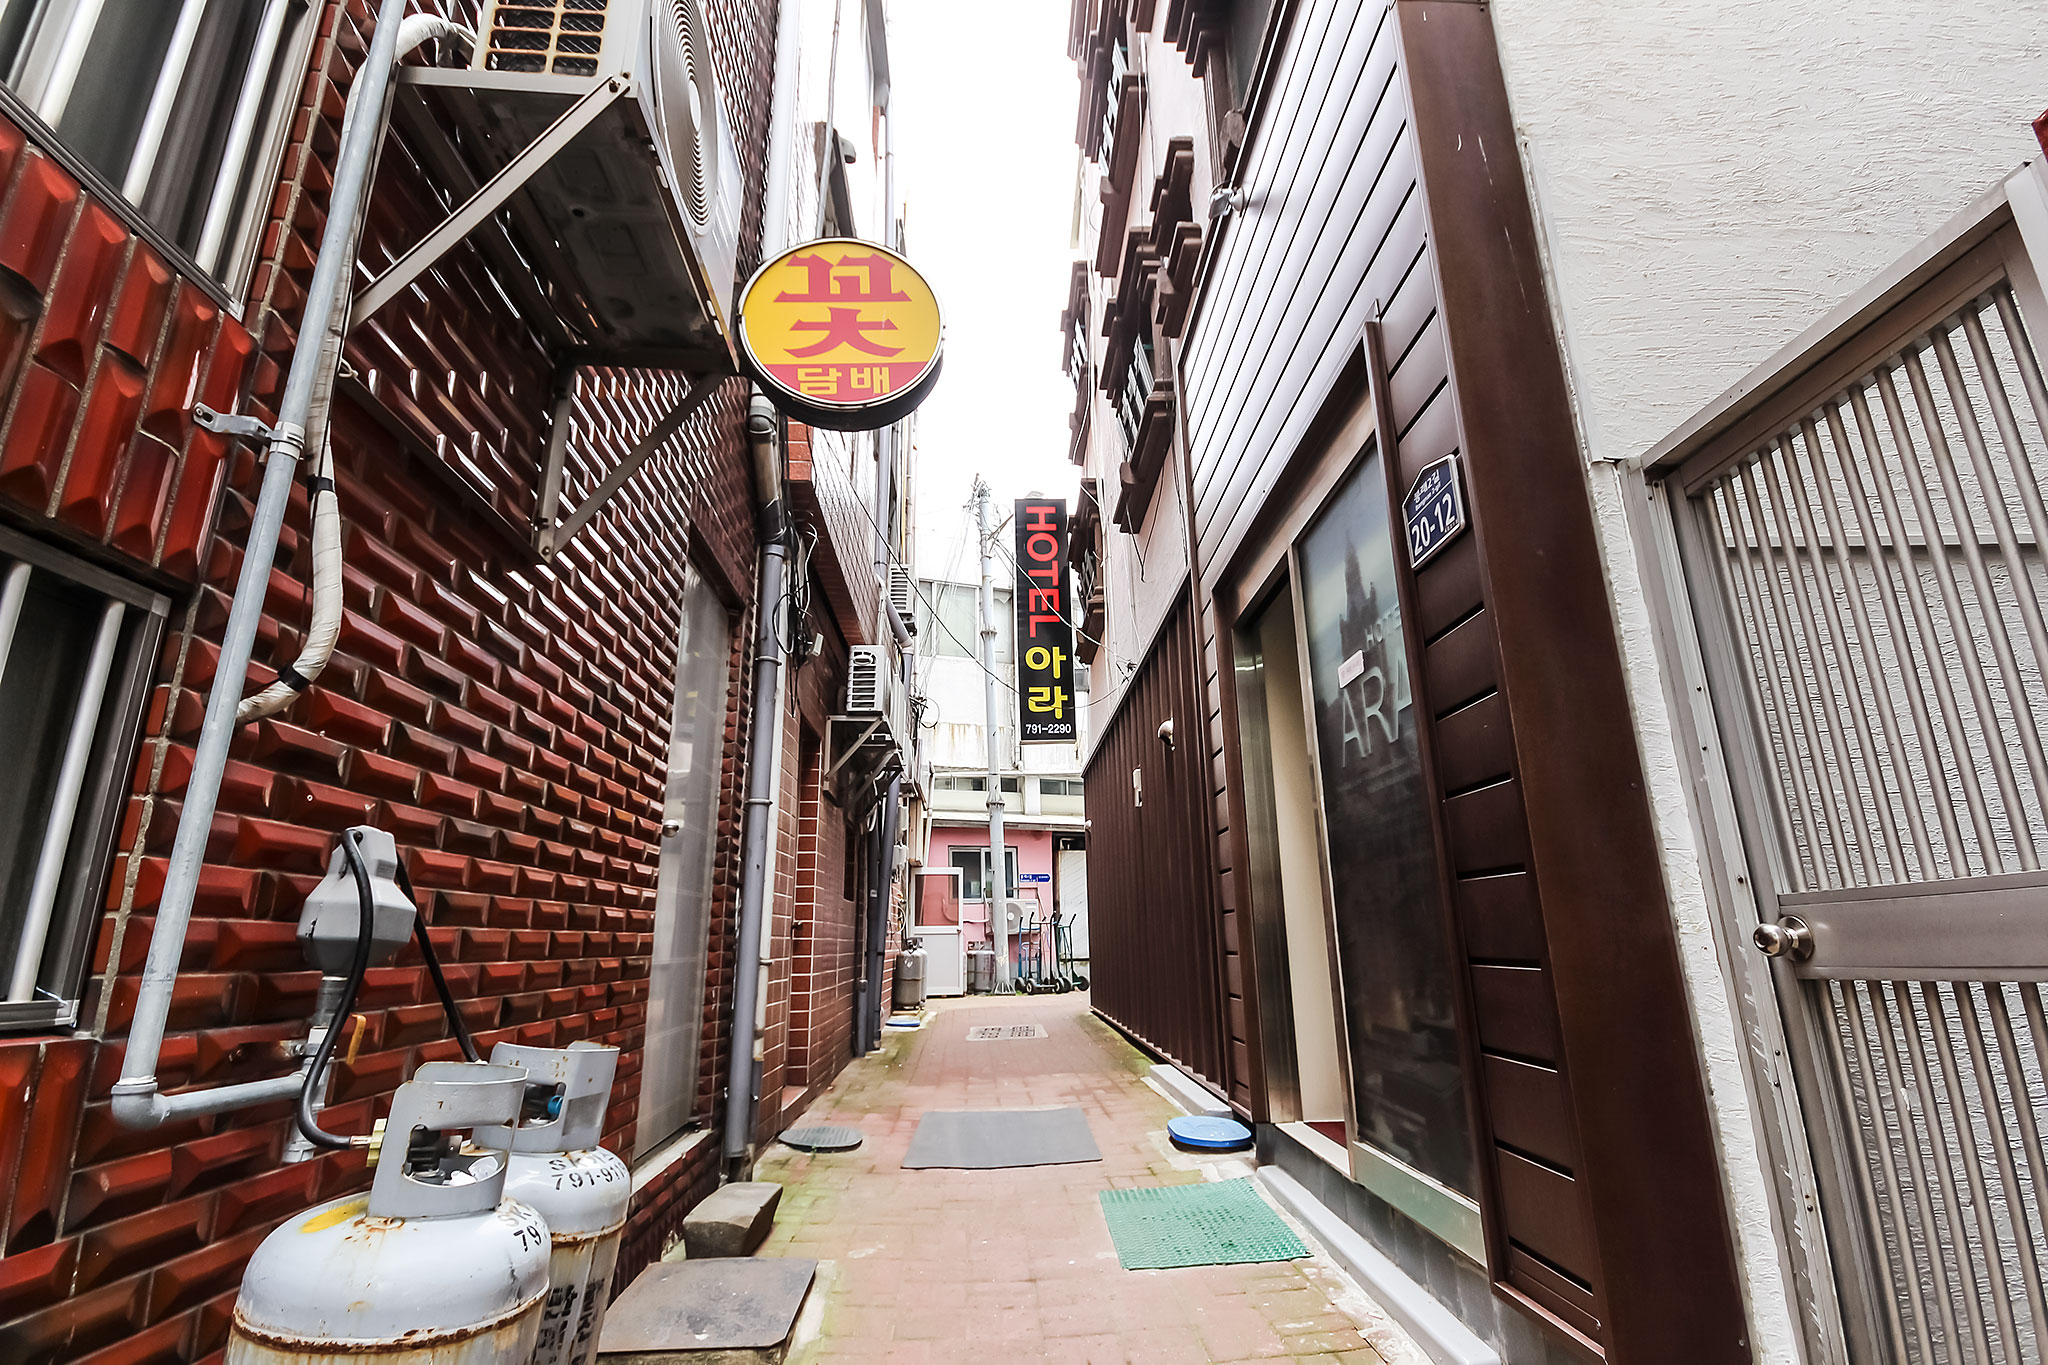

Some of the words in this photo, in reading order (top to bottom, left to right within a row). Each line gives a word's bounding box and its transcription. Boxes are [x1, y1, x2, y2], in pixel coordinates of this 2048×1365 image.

[773, 253, 912, 358] 꽃
[797, 366, 891, 396] 담배
[1411, 493, 1455, 557] 20-12
[1025, 505, 1061, 639] HOTEL
[1025, 645, 1069, 720] 아라
[1025, 722, 1072, 736] 791-2290
